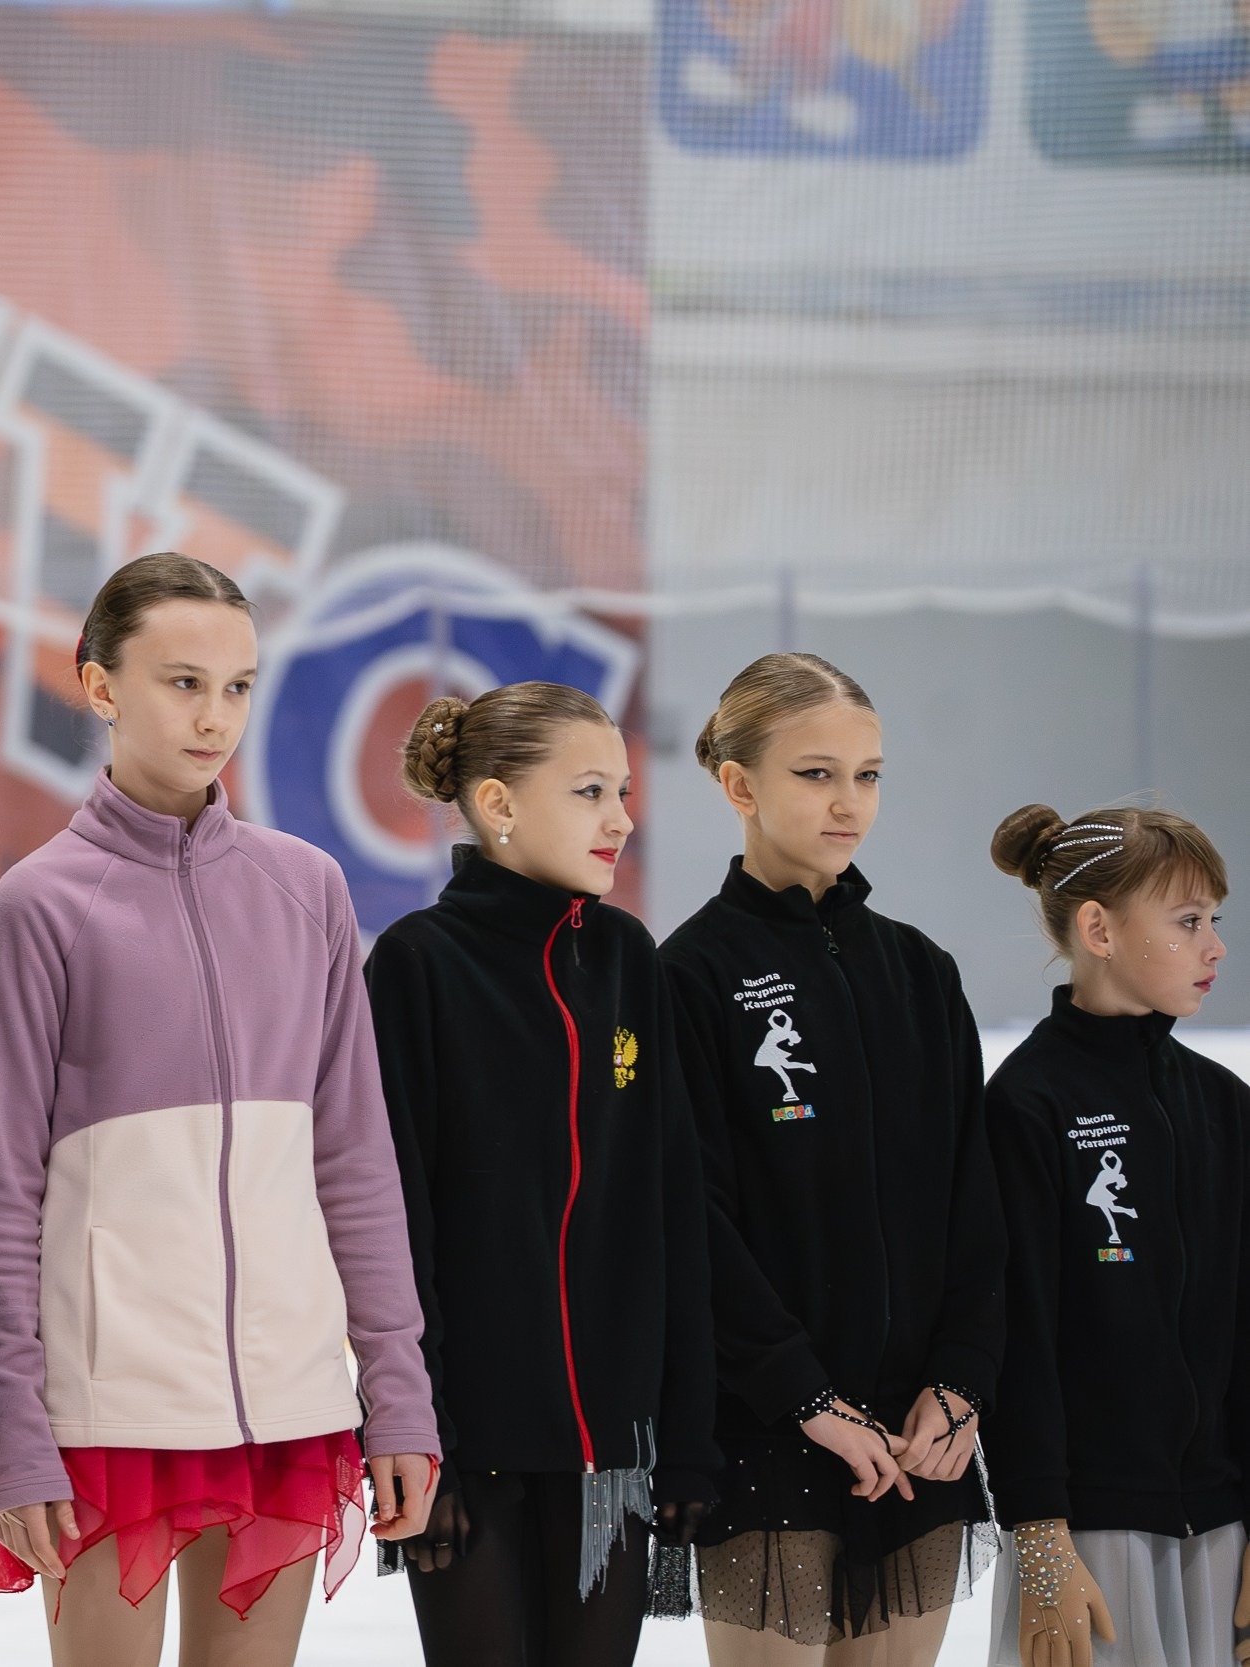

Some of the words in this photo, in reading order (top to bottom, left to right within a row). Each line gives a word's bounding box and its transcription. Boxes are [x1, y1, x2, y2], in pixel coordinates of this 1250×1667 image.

[742, 972, 781, 988] Школа
[733, 983, 796, 1001] Фигурного
[743, 994, 795, 1011] Катания
[1075, 1113, 1116, 1125] Школа
[1067, 1124, 1130, 1140] Фигурного
[1076, 1136, 1127, 1150] Катания
